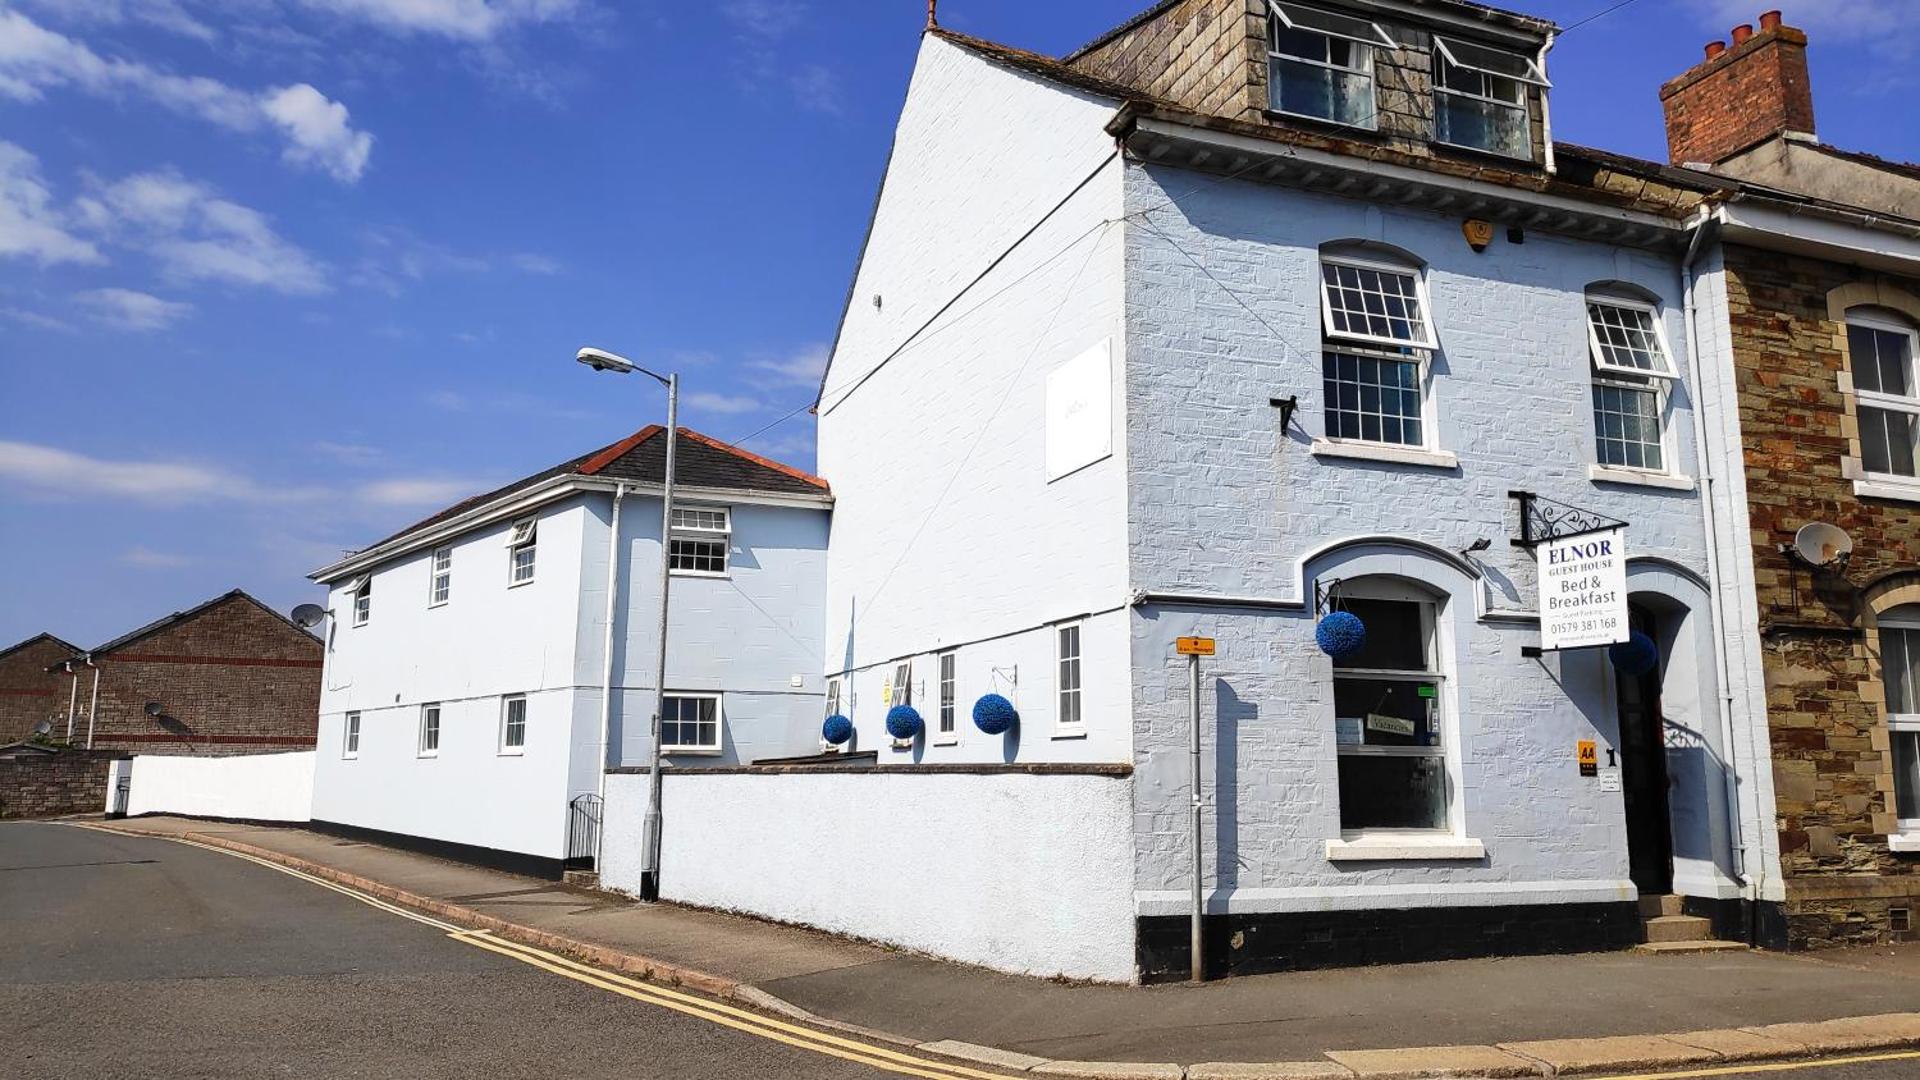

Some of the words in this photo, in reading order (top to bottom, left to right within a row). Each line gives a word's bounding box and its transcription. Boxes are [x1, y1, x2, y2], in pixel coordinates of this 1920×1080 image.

[1549, 540, 1613, 565] ELNOR
[1549, 565, 1578, 577] GUEST
[1580, 559, 1614, 572] HOUSE
[1561, 577, 1587, 593] Bed
[1591, 575, 1601, 589] &
[1549, 591, 1616, 610] Breakfast
[1550, 621, 1578, 634] 01579
[1581, 619, 1597, 632] 381
[1600, 617, 1617, 629] 168
[1581, 746, 1595, 760] AA
[1606, 748, 1617, 767] 1
